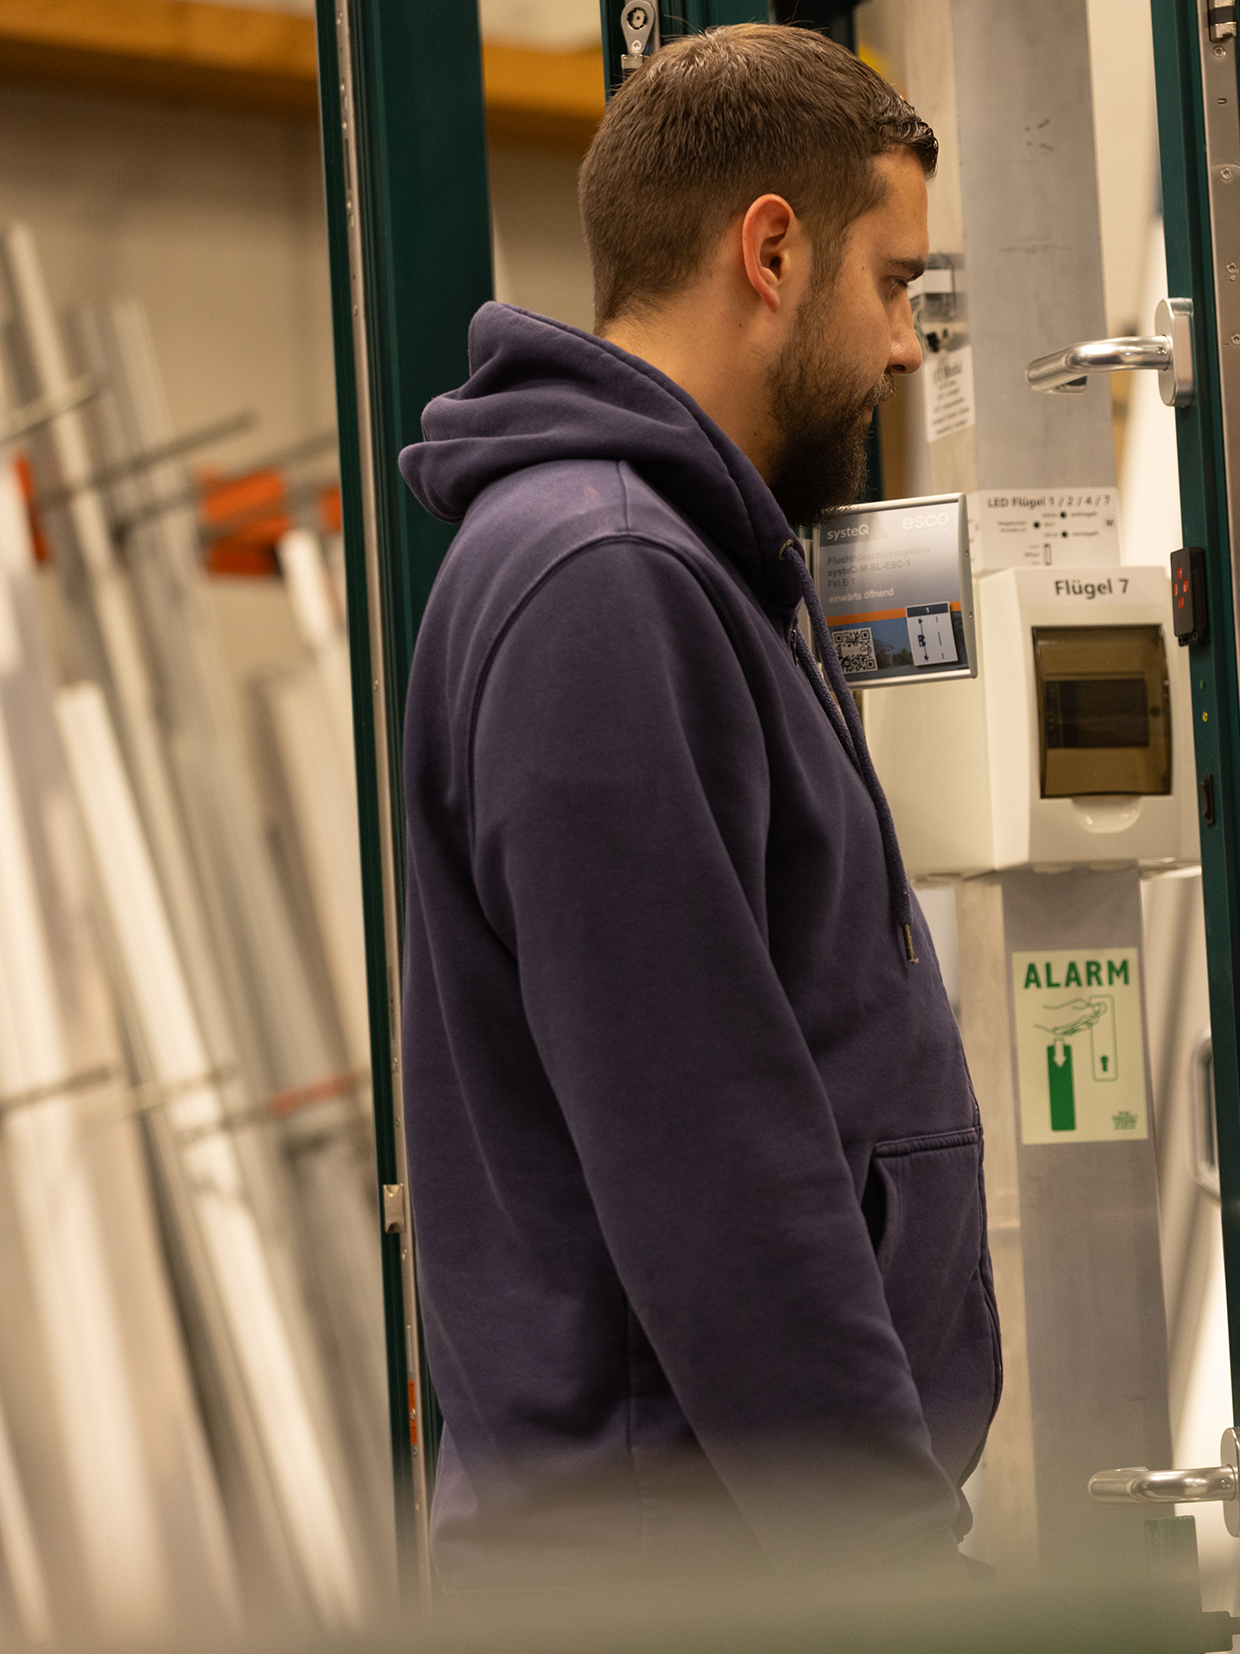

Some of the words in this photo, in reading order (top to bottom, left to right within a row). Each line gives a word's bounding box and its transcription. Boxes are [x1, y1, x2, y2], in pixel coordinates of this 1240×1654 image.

[988, 497, 1009, 508] LED
[1012, 496, 1045, 509] Flügel
[902, 512, 949, 530] esco
[826, 523, 870, 541] systeQ
[1055, 578, 1113, 600] Flügel
[1119, 578, 1129, 594] 7
[1024, 959, 1130, 990] ALARM
